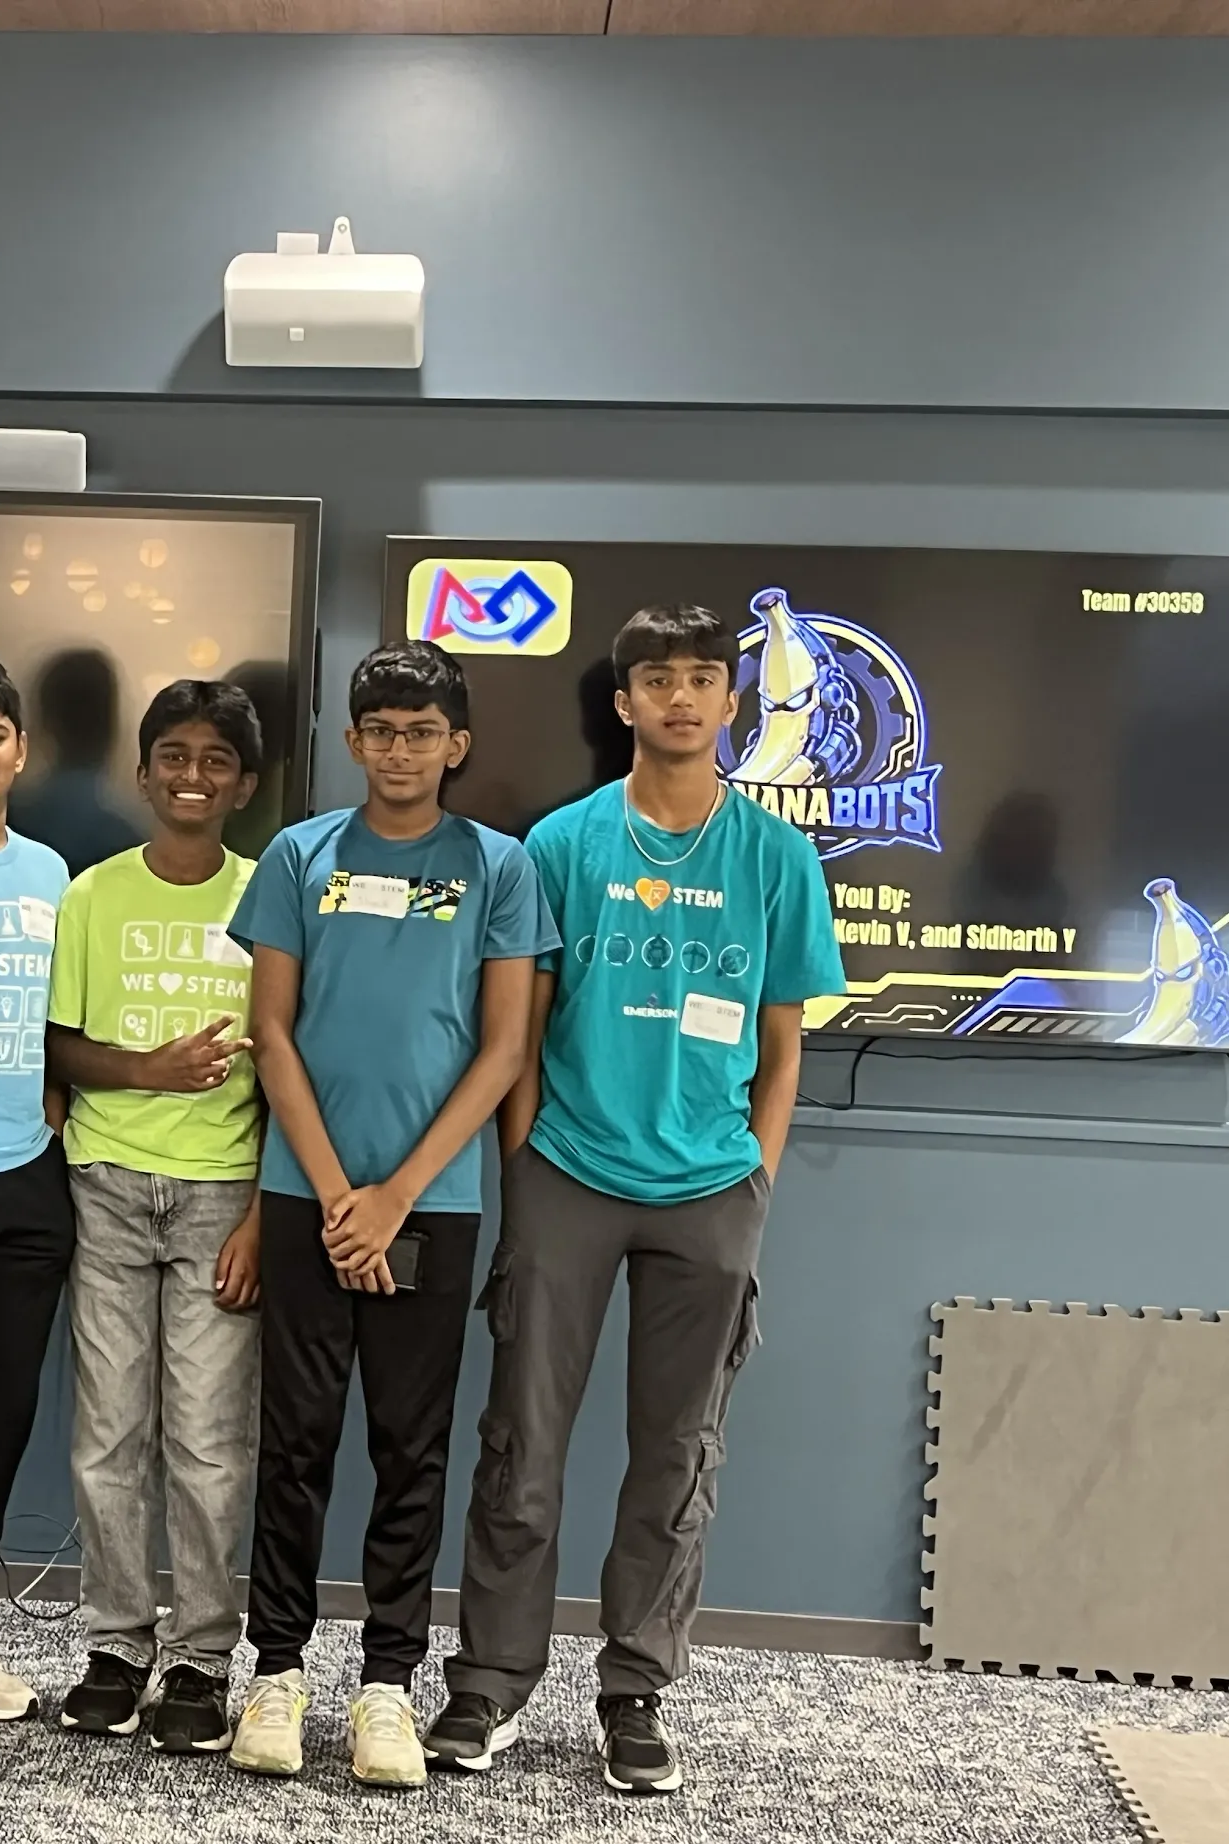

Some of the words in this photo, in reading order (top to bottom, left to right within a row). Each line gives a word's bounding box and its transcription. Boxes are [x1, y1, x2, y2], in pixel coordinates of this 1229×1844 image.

[1082, 589, 1130, 612] Team
[1135, 591, 1204, 613] #30358
[607, 883, 635, 901] We
[672, 887, 723, 908] STEM
[834, 883, 873, 909] You
[878, 885, 911, 914] By:
[833, 918, 891, 945] Kevin
[896, 921, 915, 950] V,
[920, 924, 962, 949] and
[966, 924, 1058, 952] Sidharth
[1062, 928, 1076, 953] Y
[121, 973, 155, 992] WE
[186, 976, 246, 999] STEM
[623, 1006, 678, 1018] EMERSON
